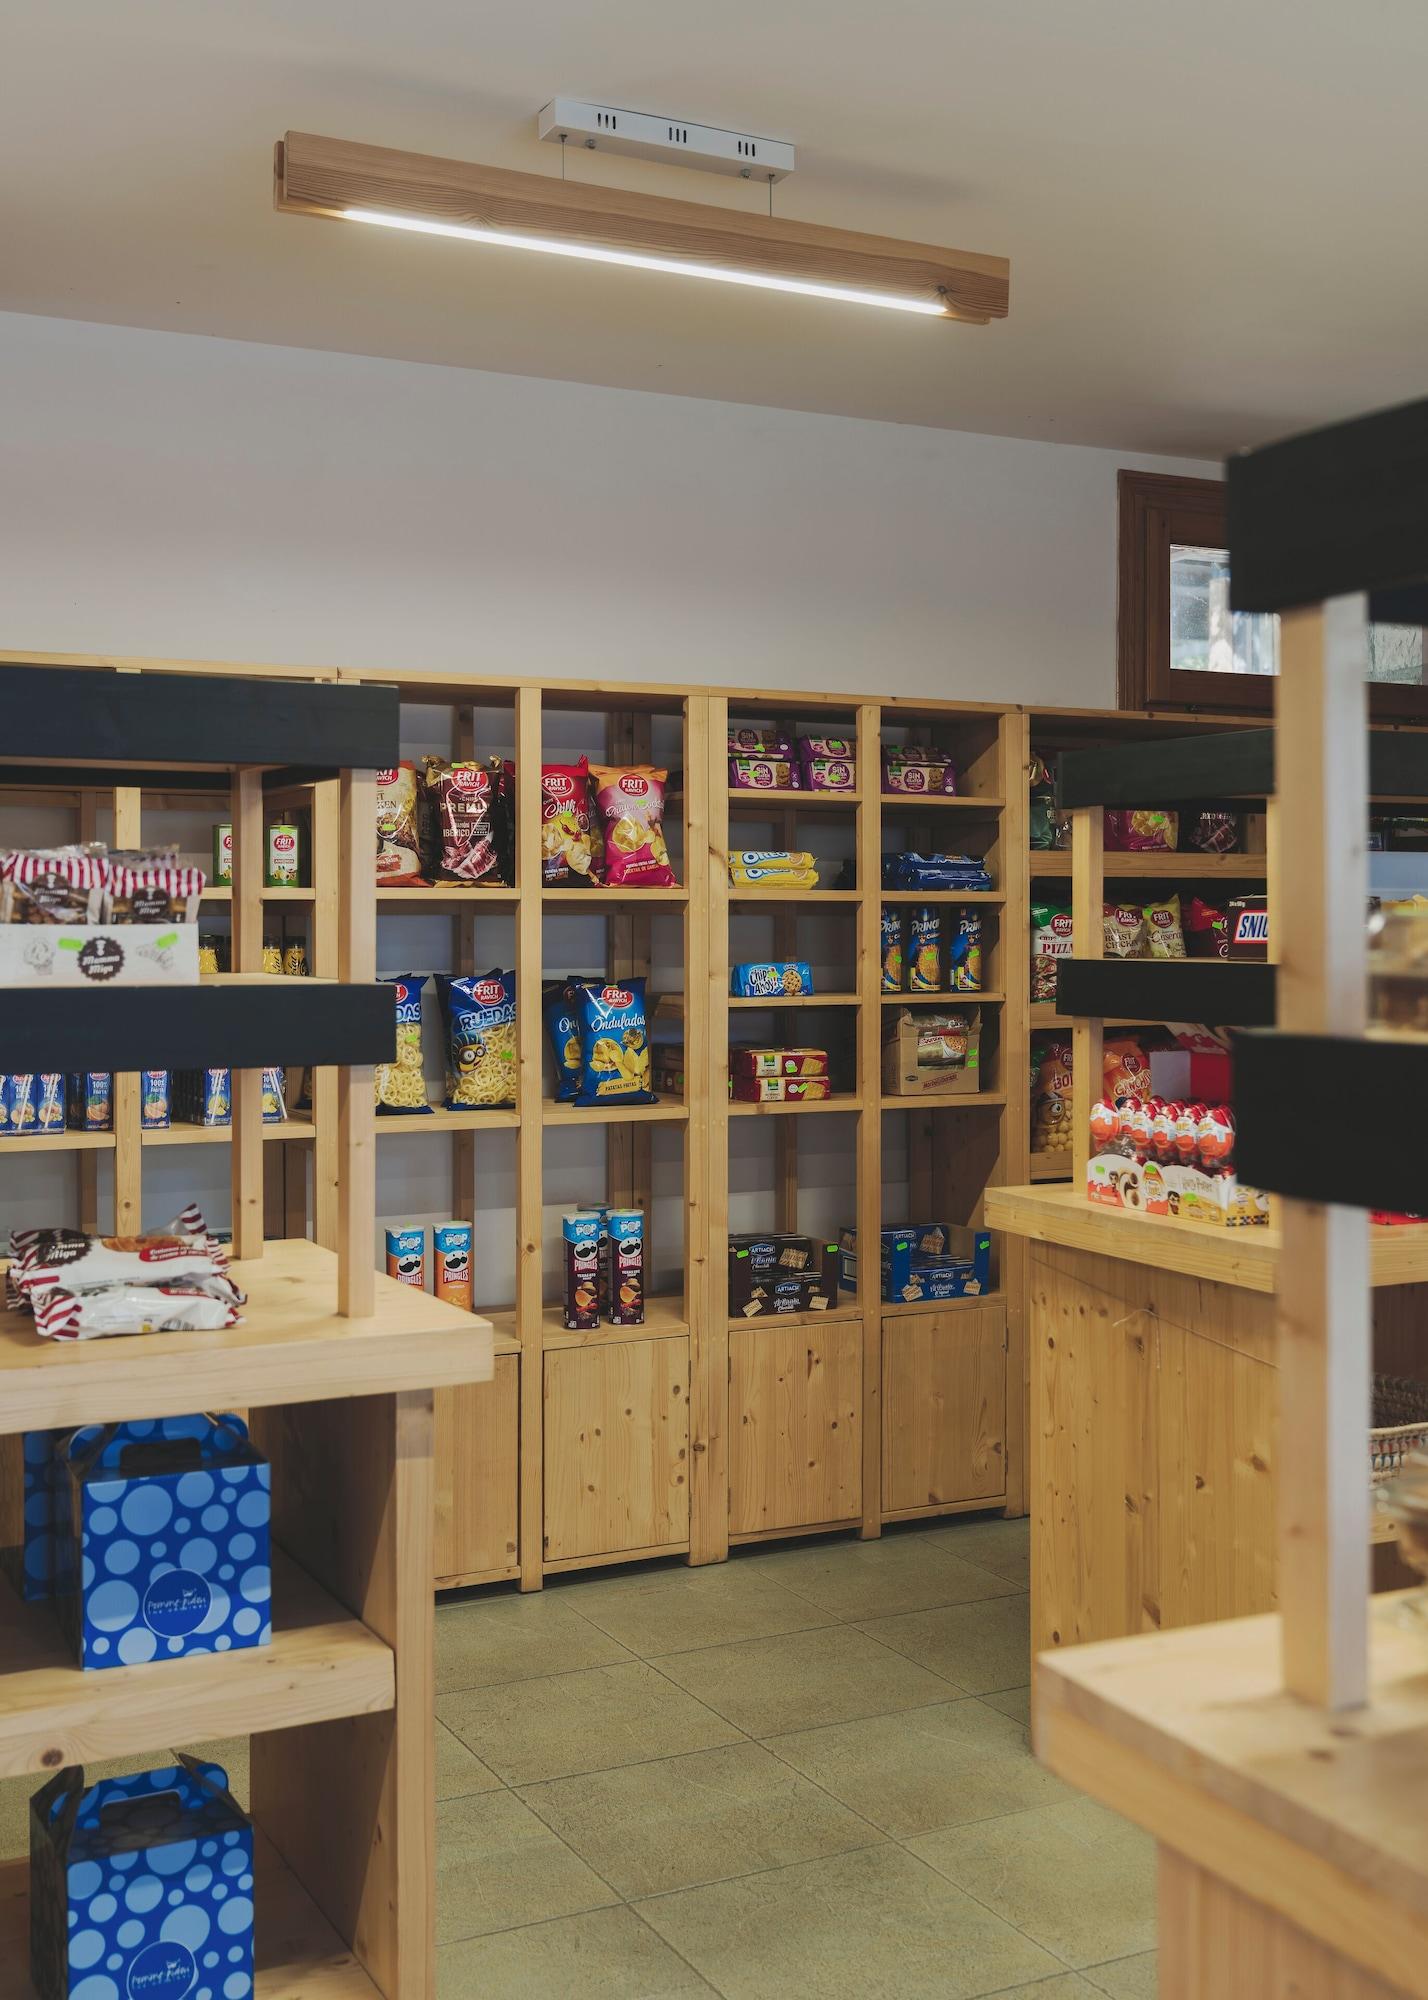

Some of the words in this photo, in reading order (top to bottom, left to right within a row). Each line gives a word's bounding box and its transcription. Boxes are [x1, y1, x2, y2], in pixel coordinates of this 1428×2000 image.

[457, 771, 482, 782] FRIT
[907, 771, 921, 780] SIN
[545, 777, 567, 788] FRIT
[622, 778, 645, 789] FRIT
[276, 837, 293, 846] FRIT
[134, 899, 167, 908] Mamma
[1153, 911, 1170, 921] FRIT
[82, 954, 120, 964] Mamma
[88, 963, 114, 975] Miga
[477, 984, 501, 996] FRIT
[396, 1003, 421, 1023] DAS
[576, 1223, 597, 1236] POP
[621, 1221, 641, 1233] POP
[398, 1237, 421, 1250] POP
[446, 1233, 468, 1247] POP
[751, 1246, 774, 1254] ARTIACH
[619, 1254, 642, 1269] PRINGLES
[444, 1268, 469, 1282] PRINGLES
[931, 1272, 953, 1280] ARTIACH
[777, 1284, 800, 1293] ARTIACH
